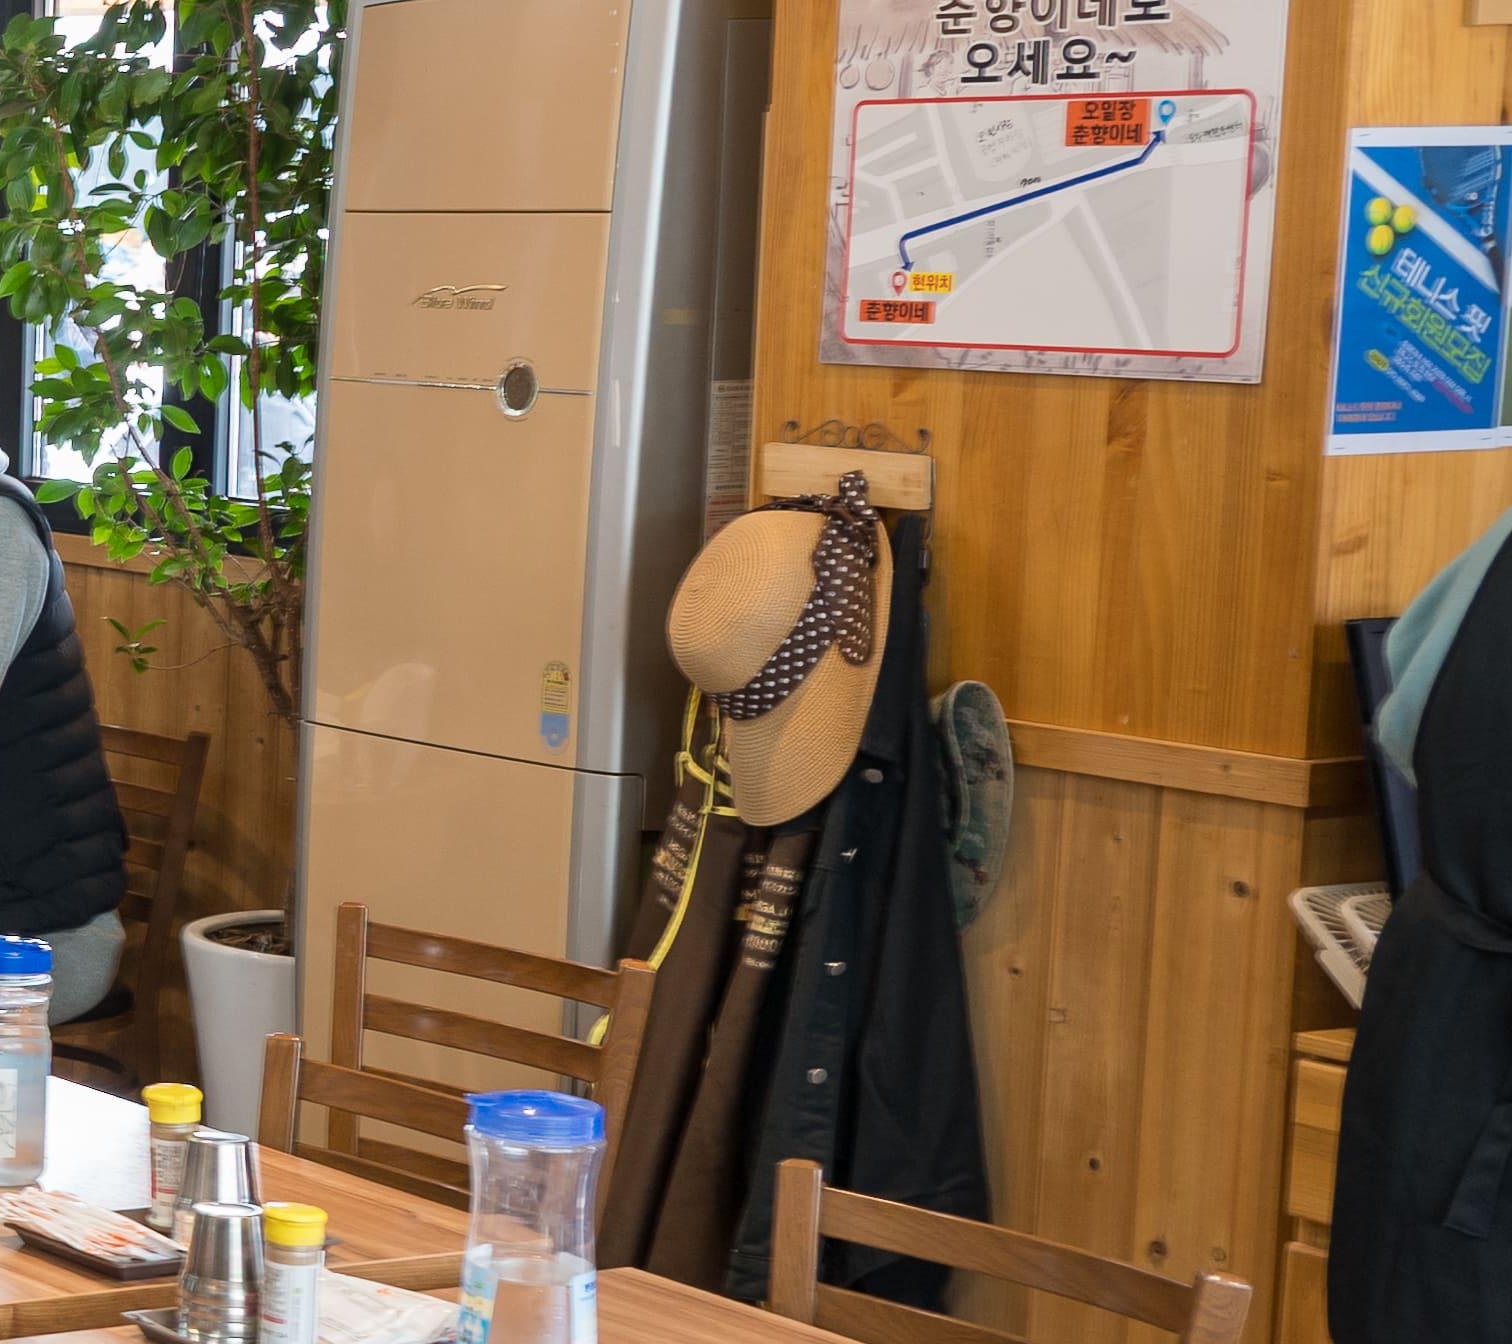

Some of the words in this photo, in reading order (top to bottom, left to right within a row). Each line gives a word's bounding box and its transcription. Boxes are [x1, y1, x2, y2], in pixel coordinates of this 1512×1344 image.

[961, 37, 1137, 84] 오세요~
[1082, 101, 1136, 122] 오일장
[1071, 123, 1144, 145] 춘향이네
[912, 272, 952, 292] 현위치
[1392, 247, 1461, 320] 테니스
[865, 301, 929, 323] 춘향이네
